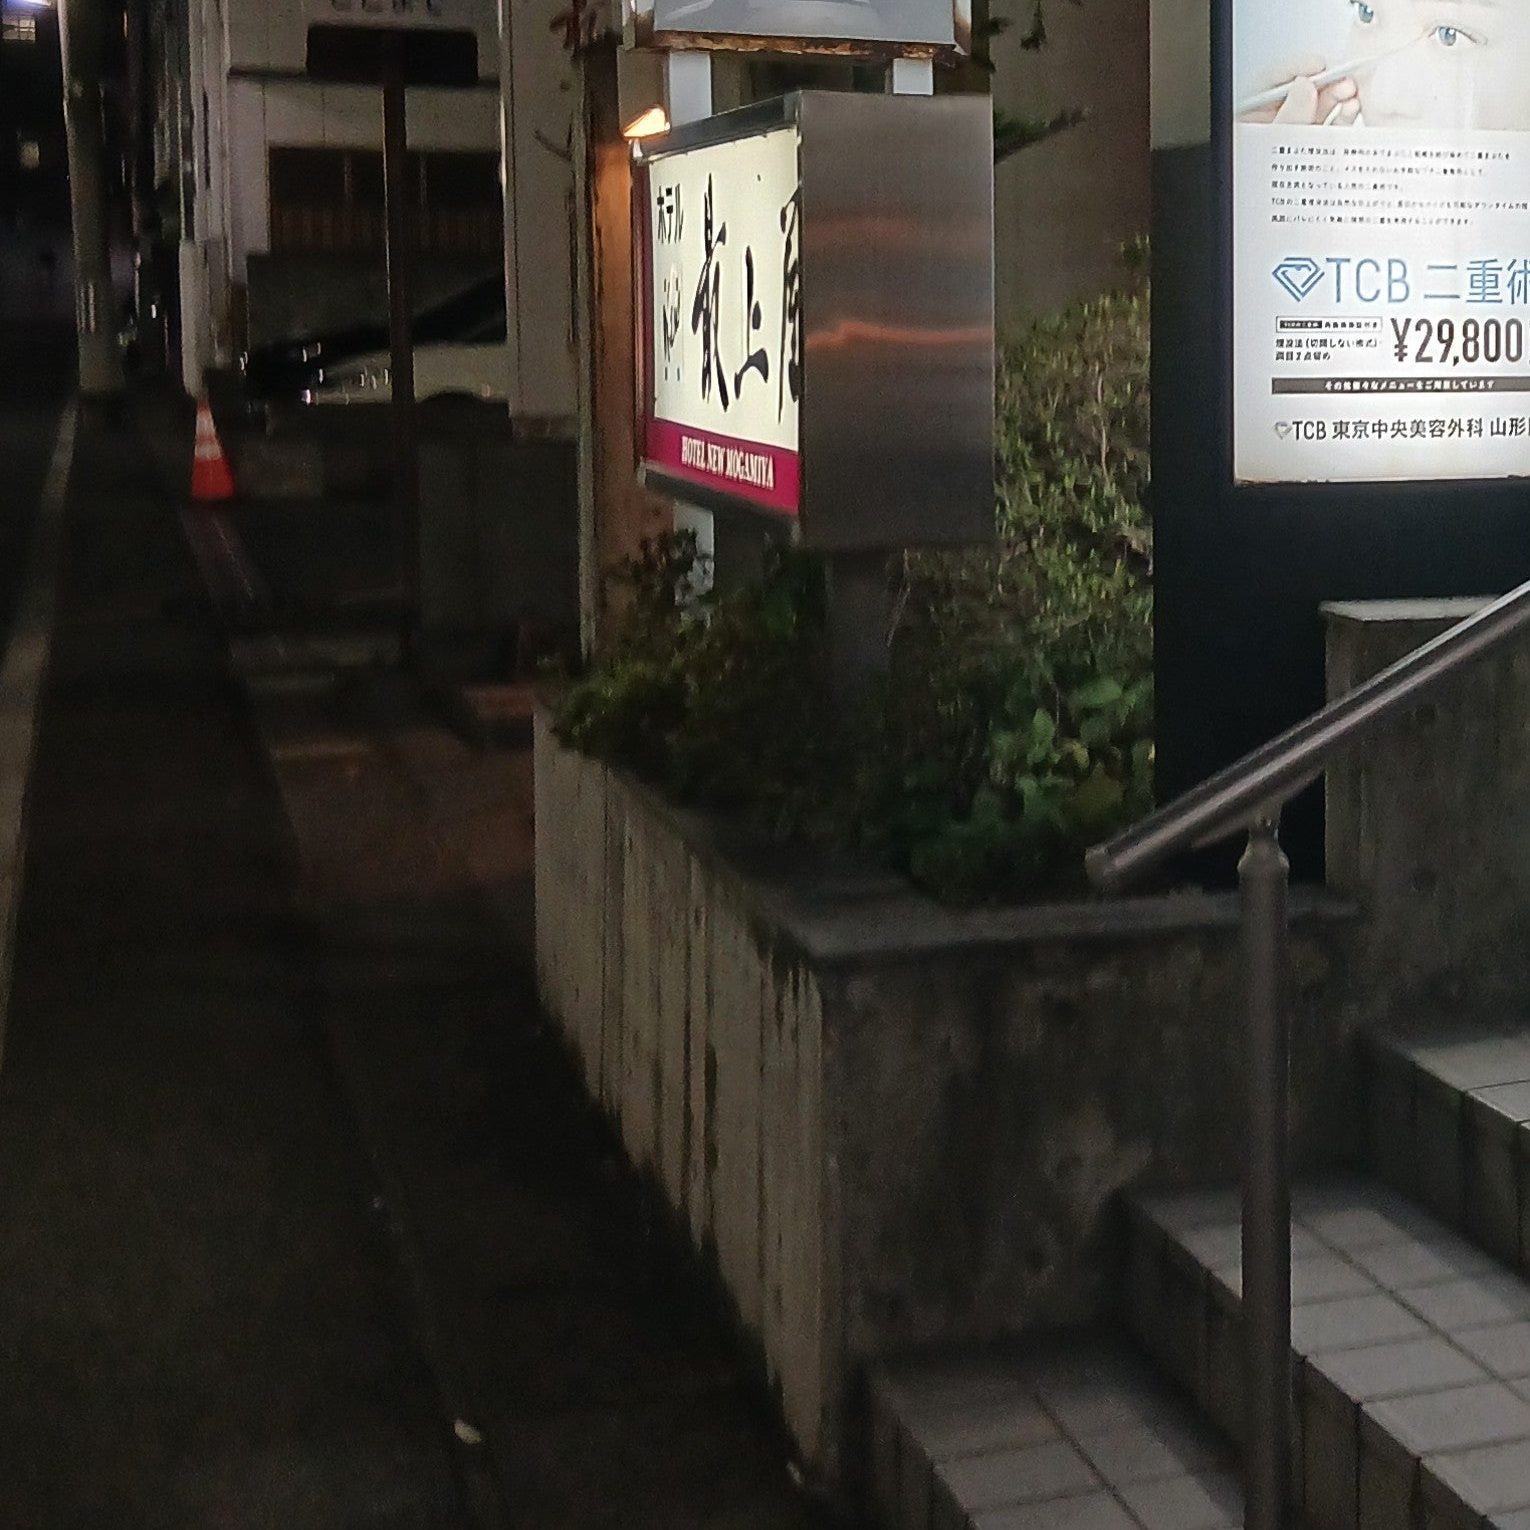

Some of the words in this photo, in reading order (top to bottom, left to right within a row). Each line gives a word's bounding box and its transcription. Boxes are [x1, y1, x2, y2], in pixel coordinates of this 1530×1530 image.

[657, 183, 684, 243] ホテル
[1325, 257, 1410, 304] TCB
[1391, 317, 1523, 367] ¥29,800
[1291, 419, 1327, 441] TCB
[1332, 417, 1484, 440] 東京中央美容外科
[682, 435, 705, 470] HOTEL
[706, 442, 725, 476] NEW
